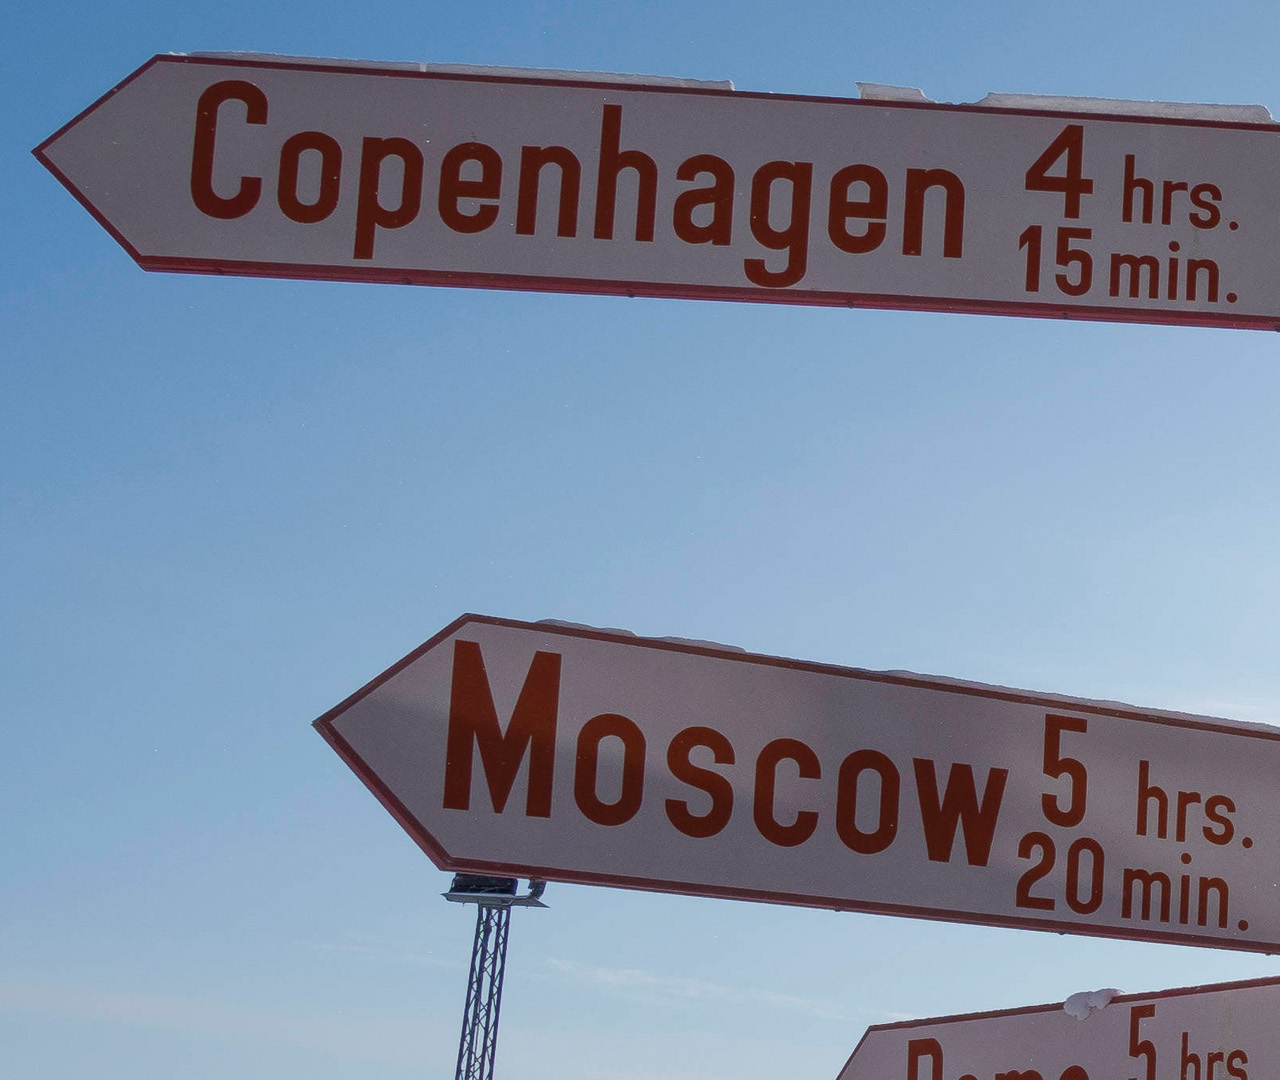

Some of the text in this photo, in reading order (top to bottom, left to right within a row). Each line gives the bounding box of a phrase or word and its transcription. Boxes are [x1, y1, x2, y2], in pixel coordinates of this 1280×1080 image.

[192, 81, 968, 289] Copenhagen
[1025, 124, 1240, 230] 4 hrs.
[1018, 224, 1239, 305] 15 min.
[443, 640, 1008, 866] Moscow
[1042, 714, 1255, 849] 5 hrs.
[1016, 832, 1250, 932] 20 min.
